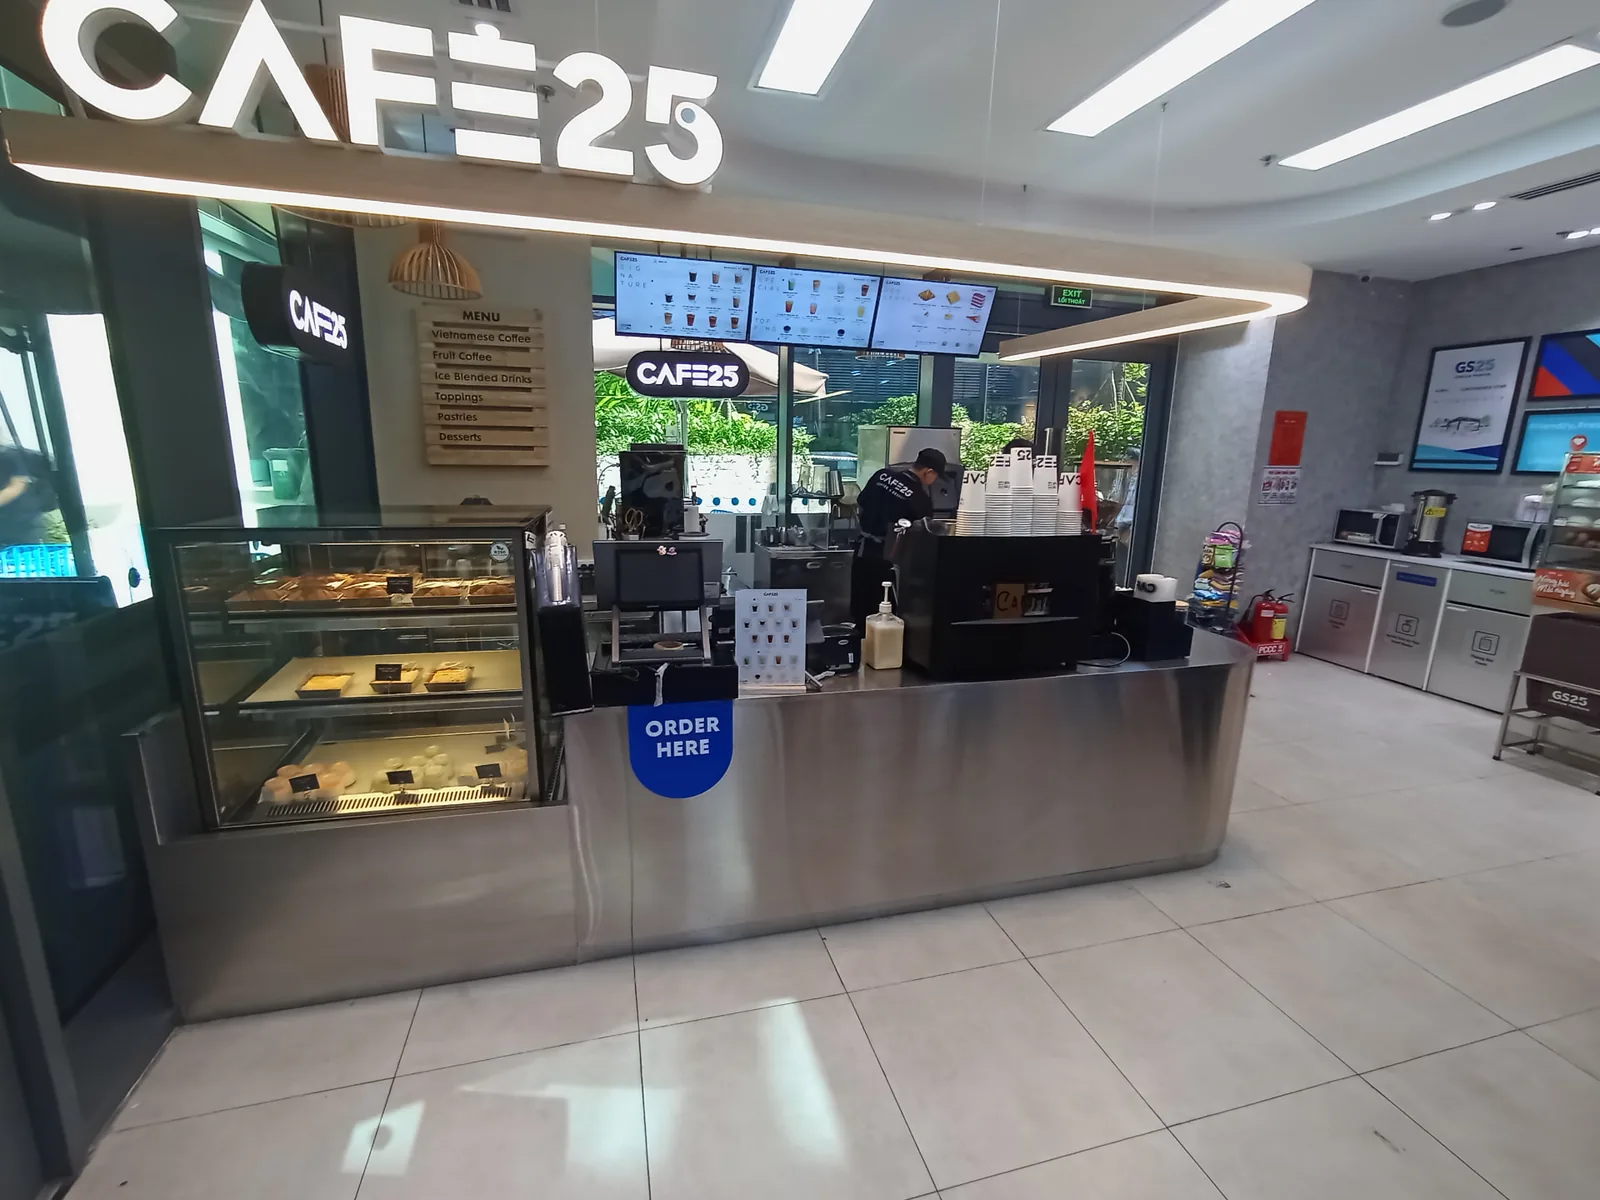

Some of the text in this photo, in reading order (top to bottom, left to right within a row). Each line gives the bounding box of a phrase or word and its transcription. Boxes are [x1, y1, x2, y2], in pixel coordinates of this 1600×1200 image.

[1062, 289, 1083, 298] EXIT
[289, 289, 348, 350] CAFE25
[462, 310, 500, 322] MENU
[432, 329, 531, 344] Vietnamese Coffee
[433, 350, 492, 362] Fruit Coffee
[1455, 358, 1496, 373] GS25
[434, 371, 533, 384] Ice Blended Drinks
[636, 362, 740, 388] CAFE25
[435, 392, 483, 403] Toppings
[437, 412, 478, 422] Pastries
[439, 432, 482, 442] Desserts
[879, 473, 914, 497] CAFE25
[1258, 646, 1277, 654] PCCC
[1552, 690, 1589, 706] GS25
[645, 716, 721, 738] ORDER
[656, 738, 710, 758] HERE
